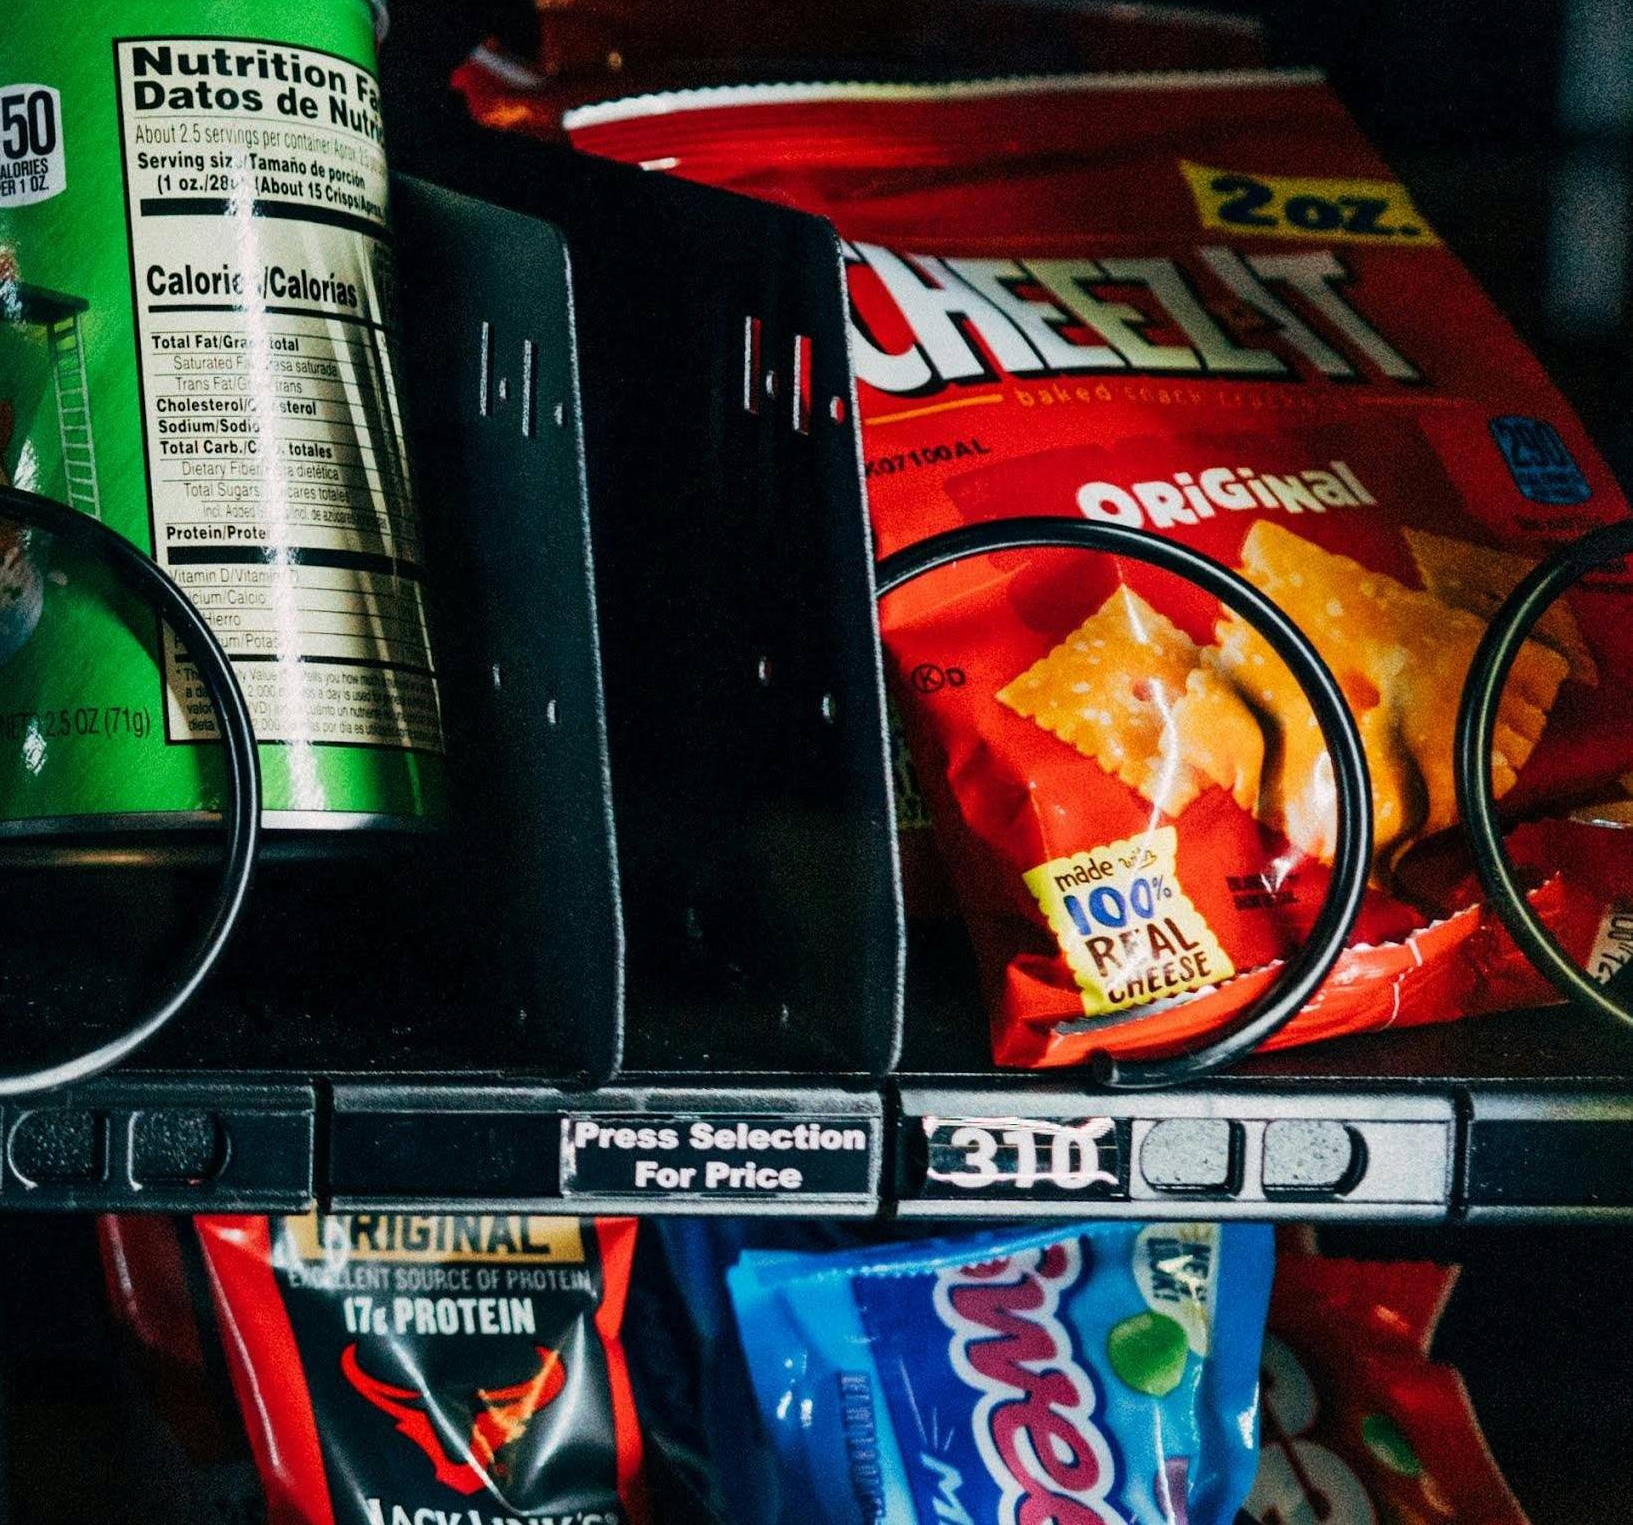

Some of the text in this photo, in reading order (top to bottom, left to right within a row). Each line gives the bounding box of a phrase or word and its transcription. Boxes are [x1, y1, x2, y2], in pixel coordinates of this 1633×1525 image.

[132, 45, 348, 96] Nutrition
[133, 80, 320, 120] Datos de
[135, 124, 178, 145] About
[179, 123, 202, 145] 2.5
[263, 129, 282, 150] per
[137, 152, 205, 171] Serving
[310, 161, 327, 178] de
[19, 179, 27, 194] 1
[29, 175, 50, 194] OZ.
[309, 182, 323, 200] 15
[151, 334, 190, 350] Total
[173, 355, 233, 372] Saturated
[160, 440, 333, 460] Total totales
[1054, 857, 1113, 893] made
[1062, 873, 1172, 937] 100%
[1084, 916, 1200, 978] REAL
[1107, 950, 1213, 1005] CHEESE
[574, 1121, 867, 1152] Press Selection
[949, 1124, 1101, 1188] 310
[634, 1160, 803, 1189] For Price
[395, 1270, 466, 1291] SOURCE
[475, 1270, 501, 1291] OF
[392, 1297, 536, 1335] PROTEIN
